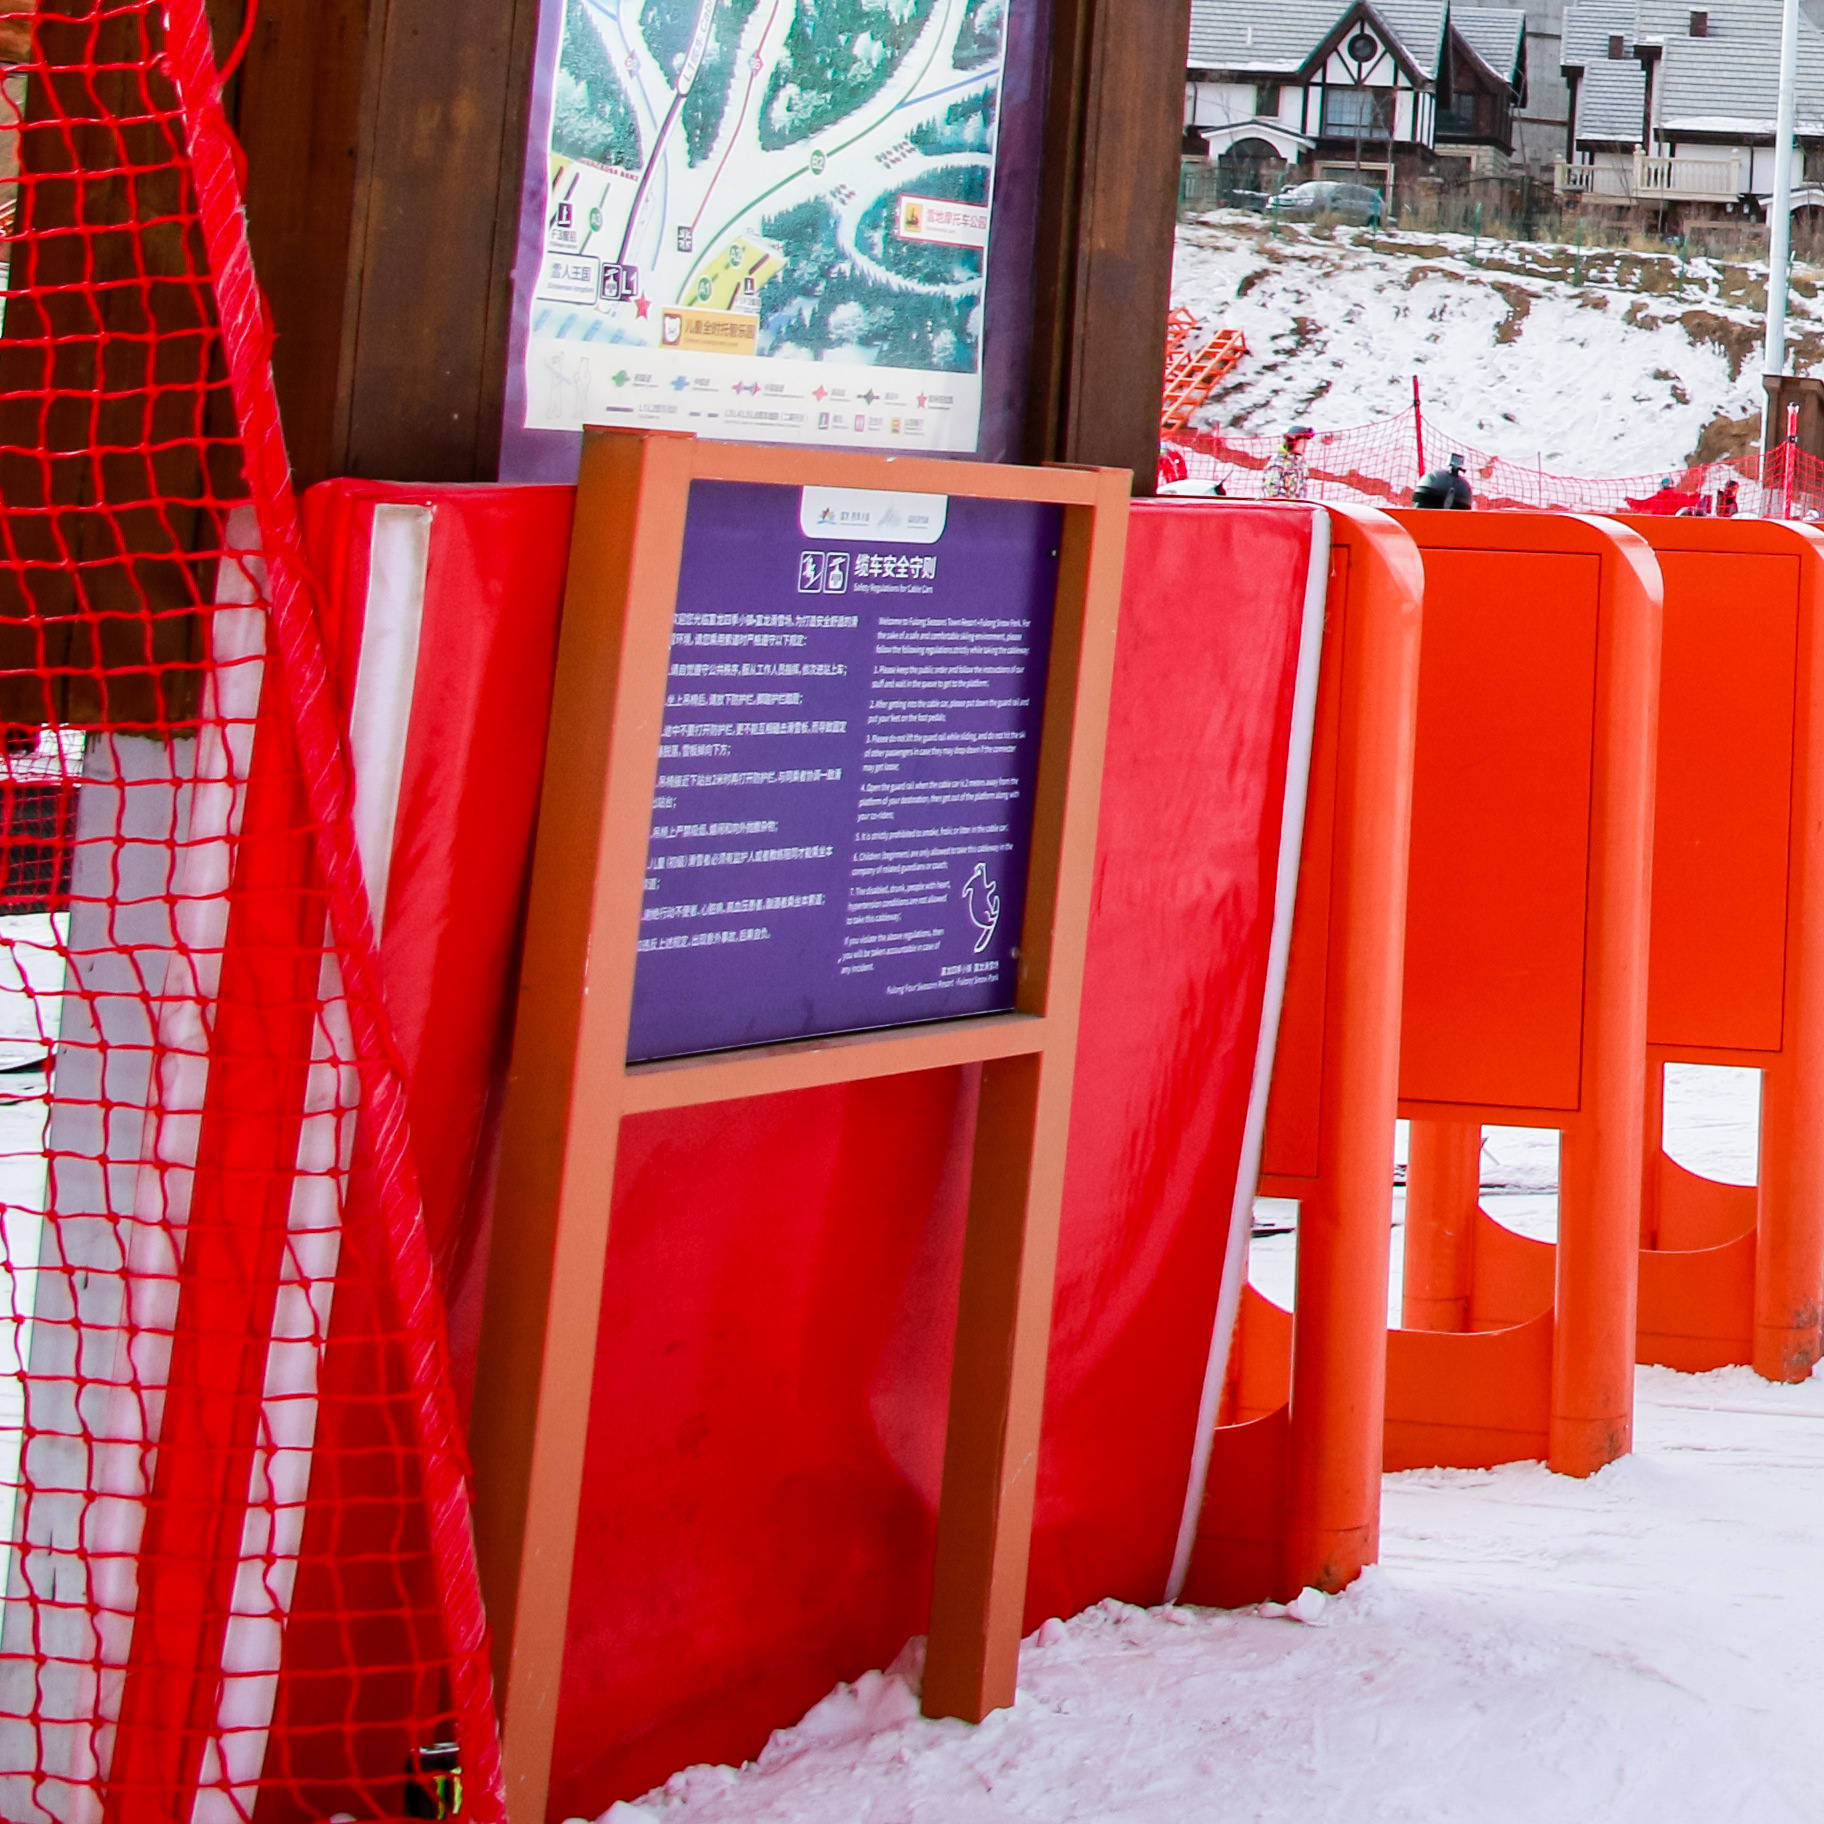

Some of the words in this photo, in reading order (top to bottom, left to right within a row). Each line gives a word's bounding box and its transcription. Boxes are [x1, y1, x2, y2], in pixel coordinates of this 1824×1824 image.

[621, 270, 638, 296] L1
[854, 553, 937, 580] 缆车安全守则
